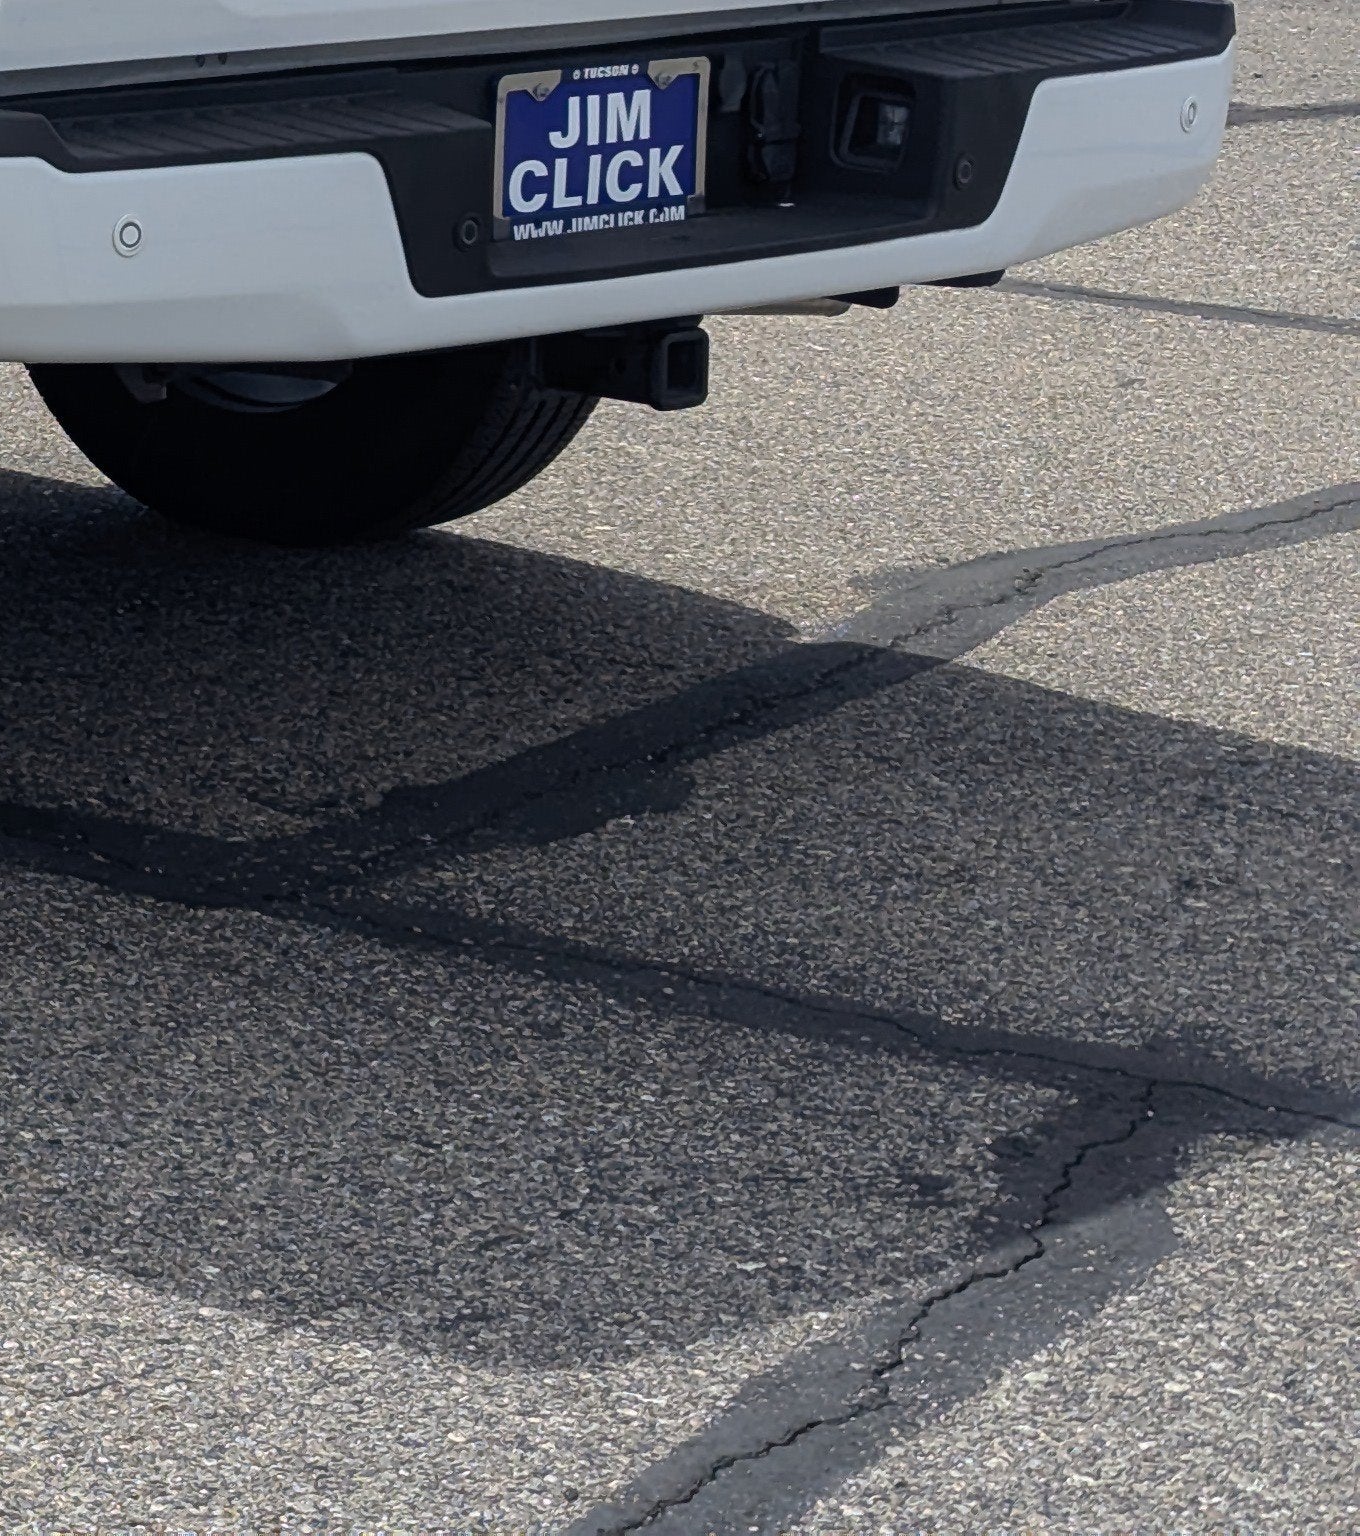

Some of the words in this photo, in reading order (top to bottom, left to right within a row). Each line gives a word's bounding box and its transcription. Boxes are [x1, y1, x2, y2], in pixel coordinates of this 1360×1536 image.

[583, 64, 630, 80] TUCSON
[548, 89, 652, 149] JIM
[508, 145, 684, 213] CLICK
